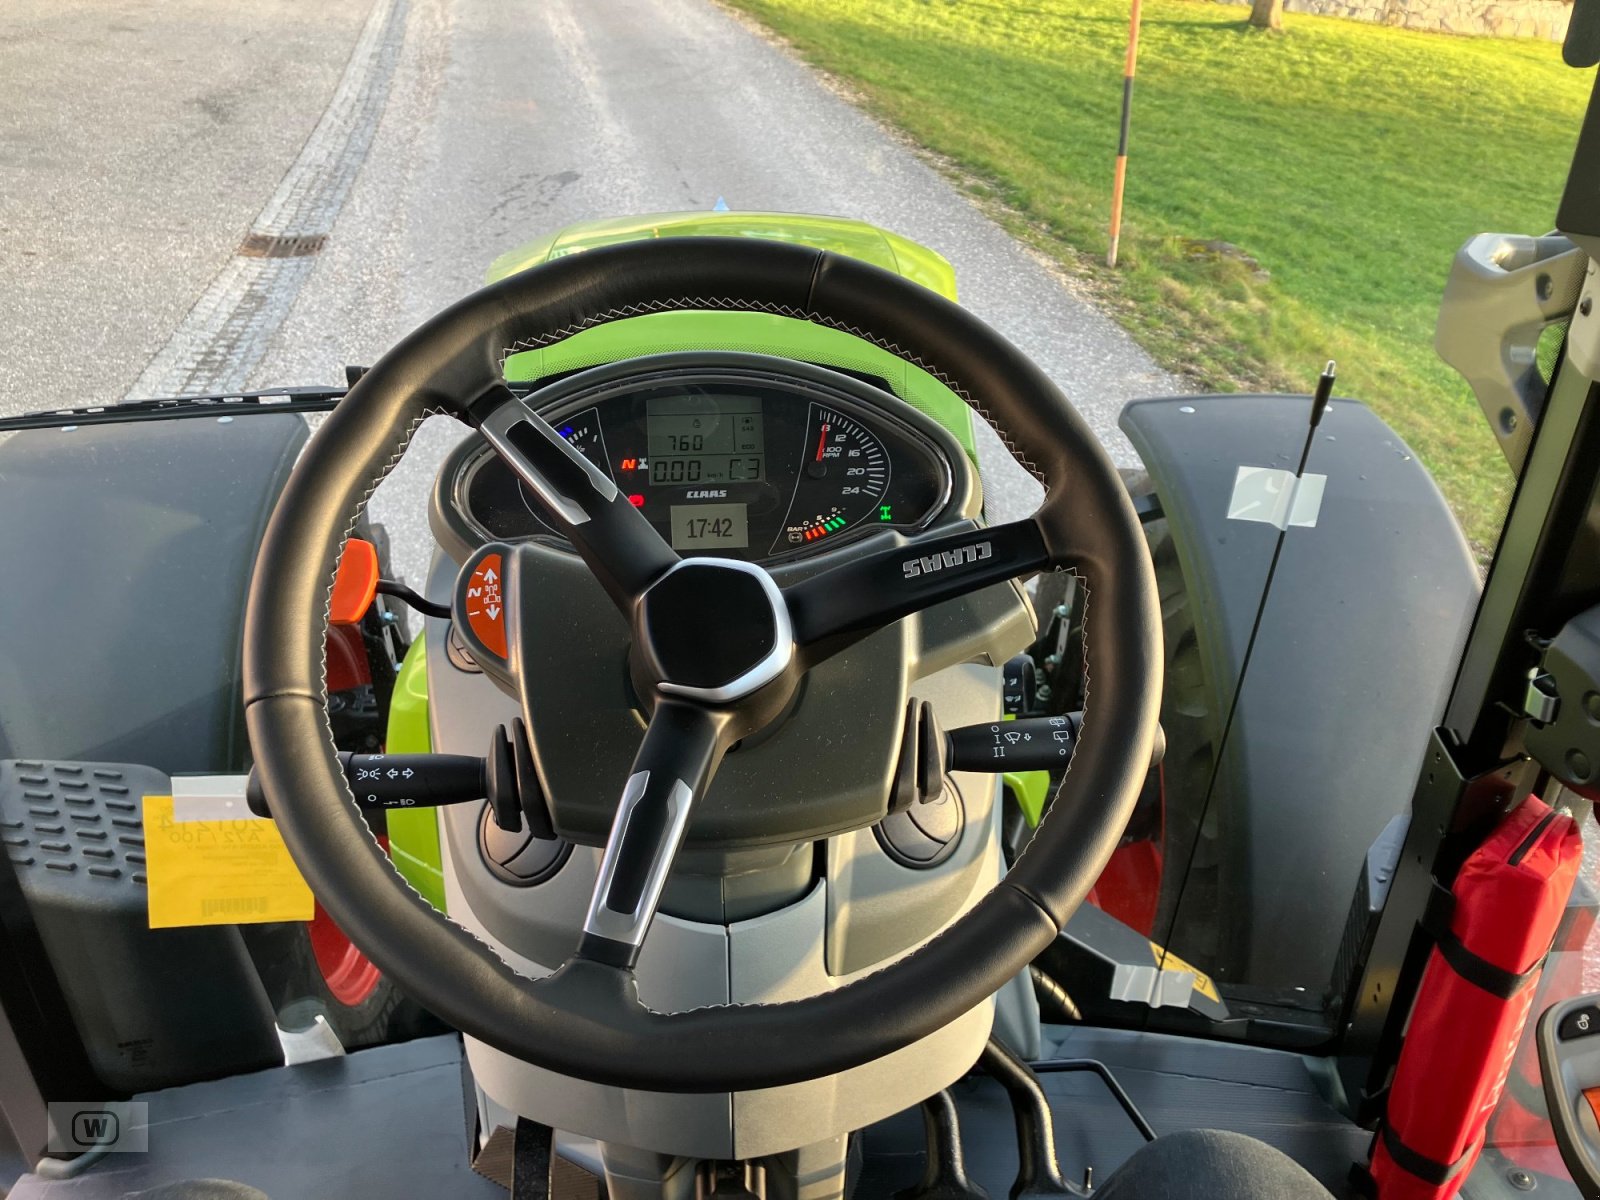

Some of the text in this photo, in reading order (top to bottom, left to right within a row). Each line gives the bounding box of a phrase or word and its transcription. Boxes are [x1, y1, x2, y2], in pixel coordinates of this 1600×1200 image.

[668, 435, 703, 451] 760
[835, 434, 847, 442] 12
[622, 458, 636, 469] N
[654, 460, 702, 483] 0.00
[847, 467, 865, 476] 20
[686, 489, 728, 499] CLAAS
[842, 486, 860, 495] 24
[686, 518, 733, 538] 17:42
[903, 541, 992, 578] CLAAS
[468, 587, 482, 598] N
